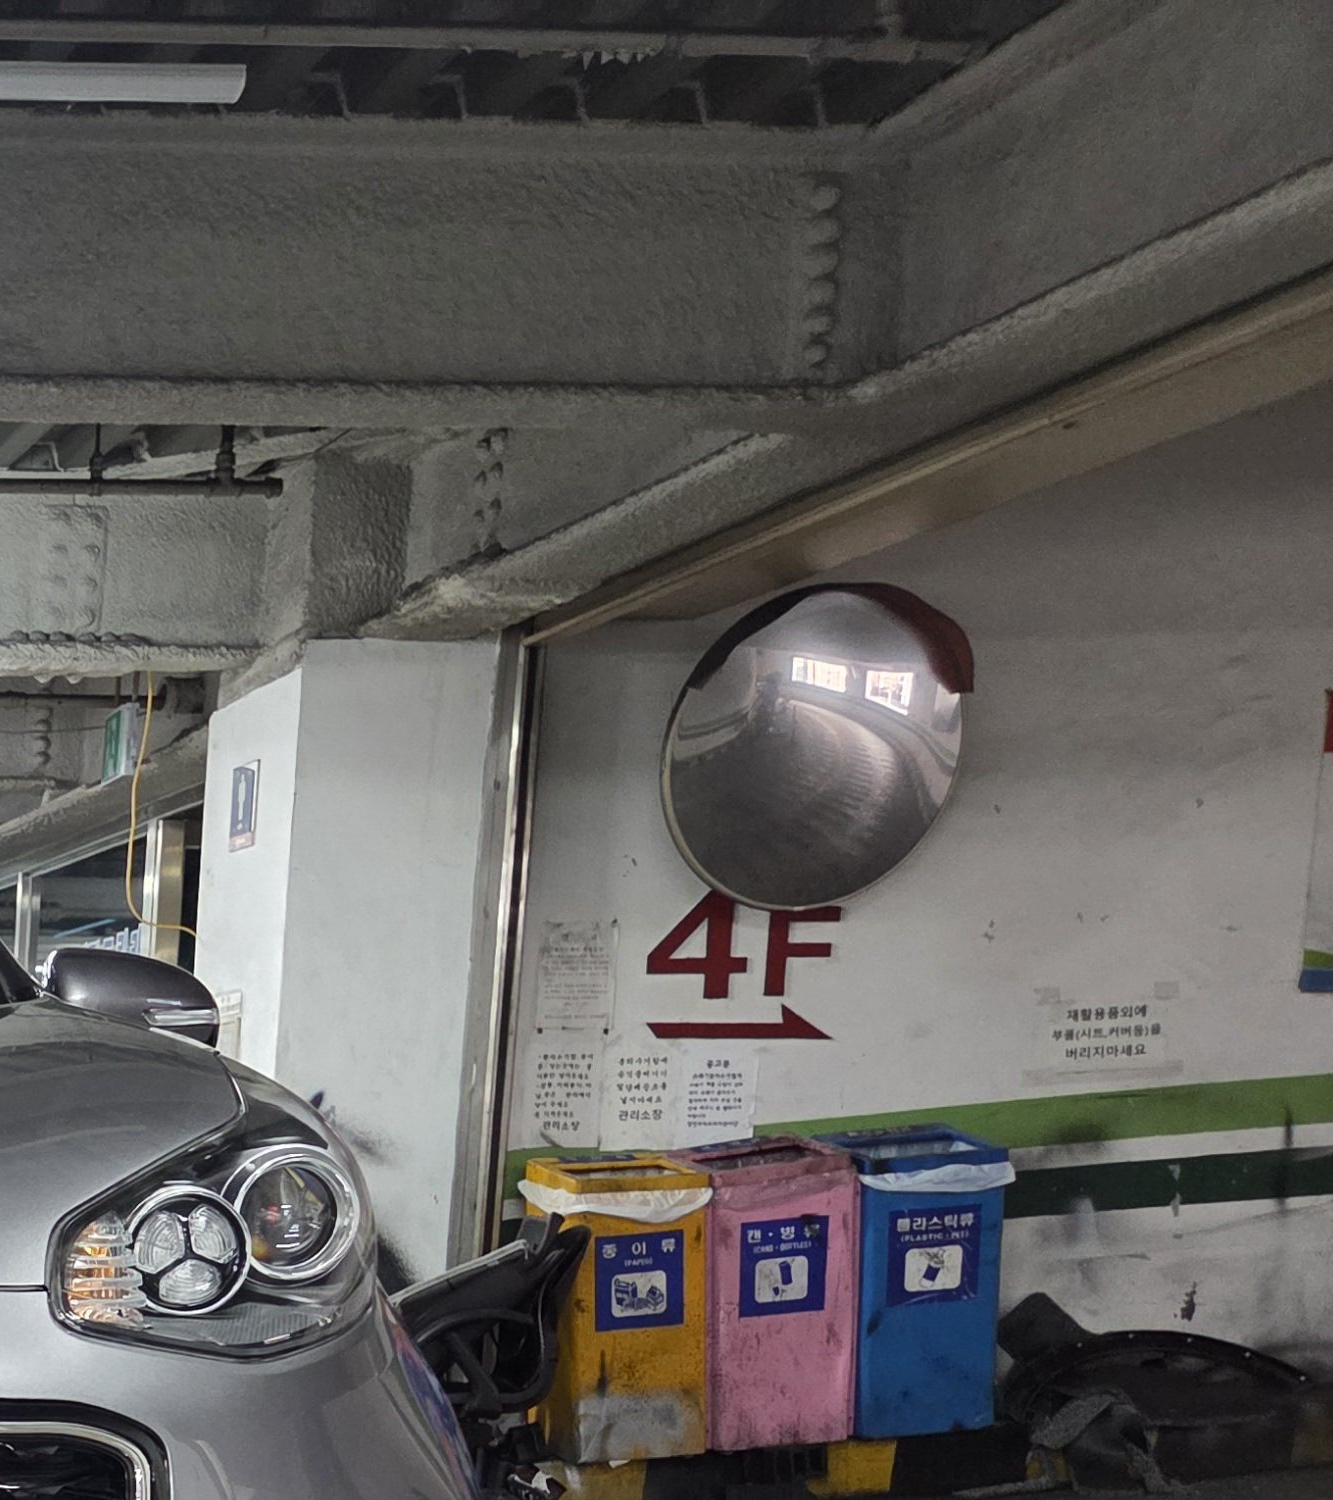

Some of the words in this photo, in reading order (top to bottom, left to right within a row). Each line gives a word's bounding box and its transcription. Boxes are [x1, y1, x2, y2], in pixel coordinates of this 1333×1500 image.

[646, 889, 842, 999] 4F
[1065, 1043, 1147, 1060] 버리지마세요
[618, 1109, 663, 1121] 관리소장
